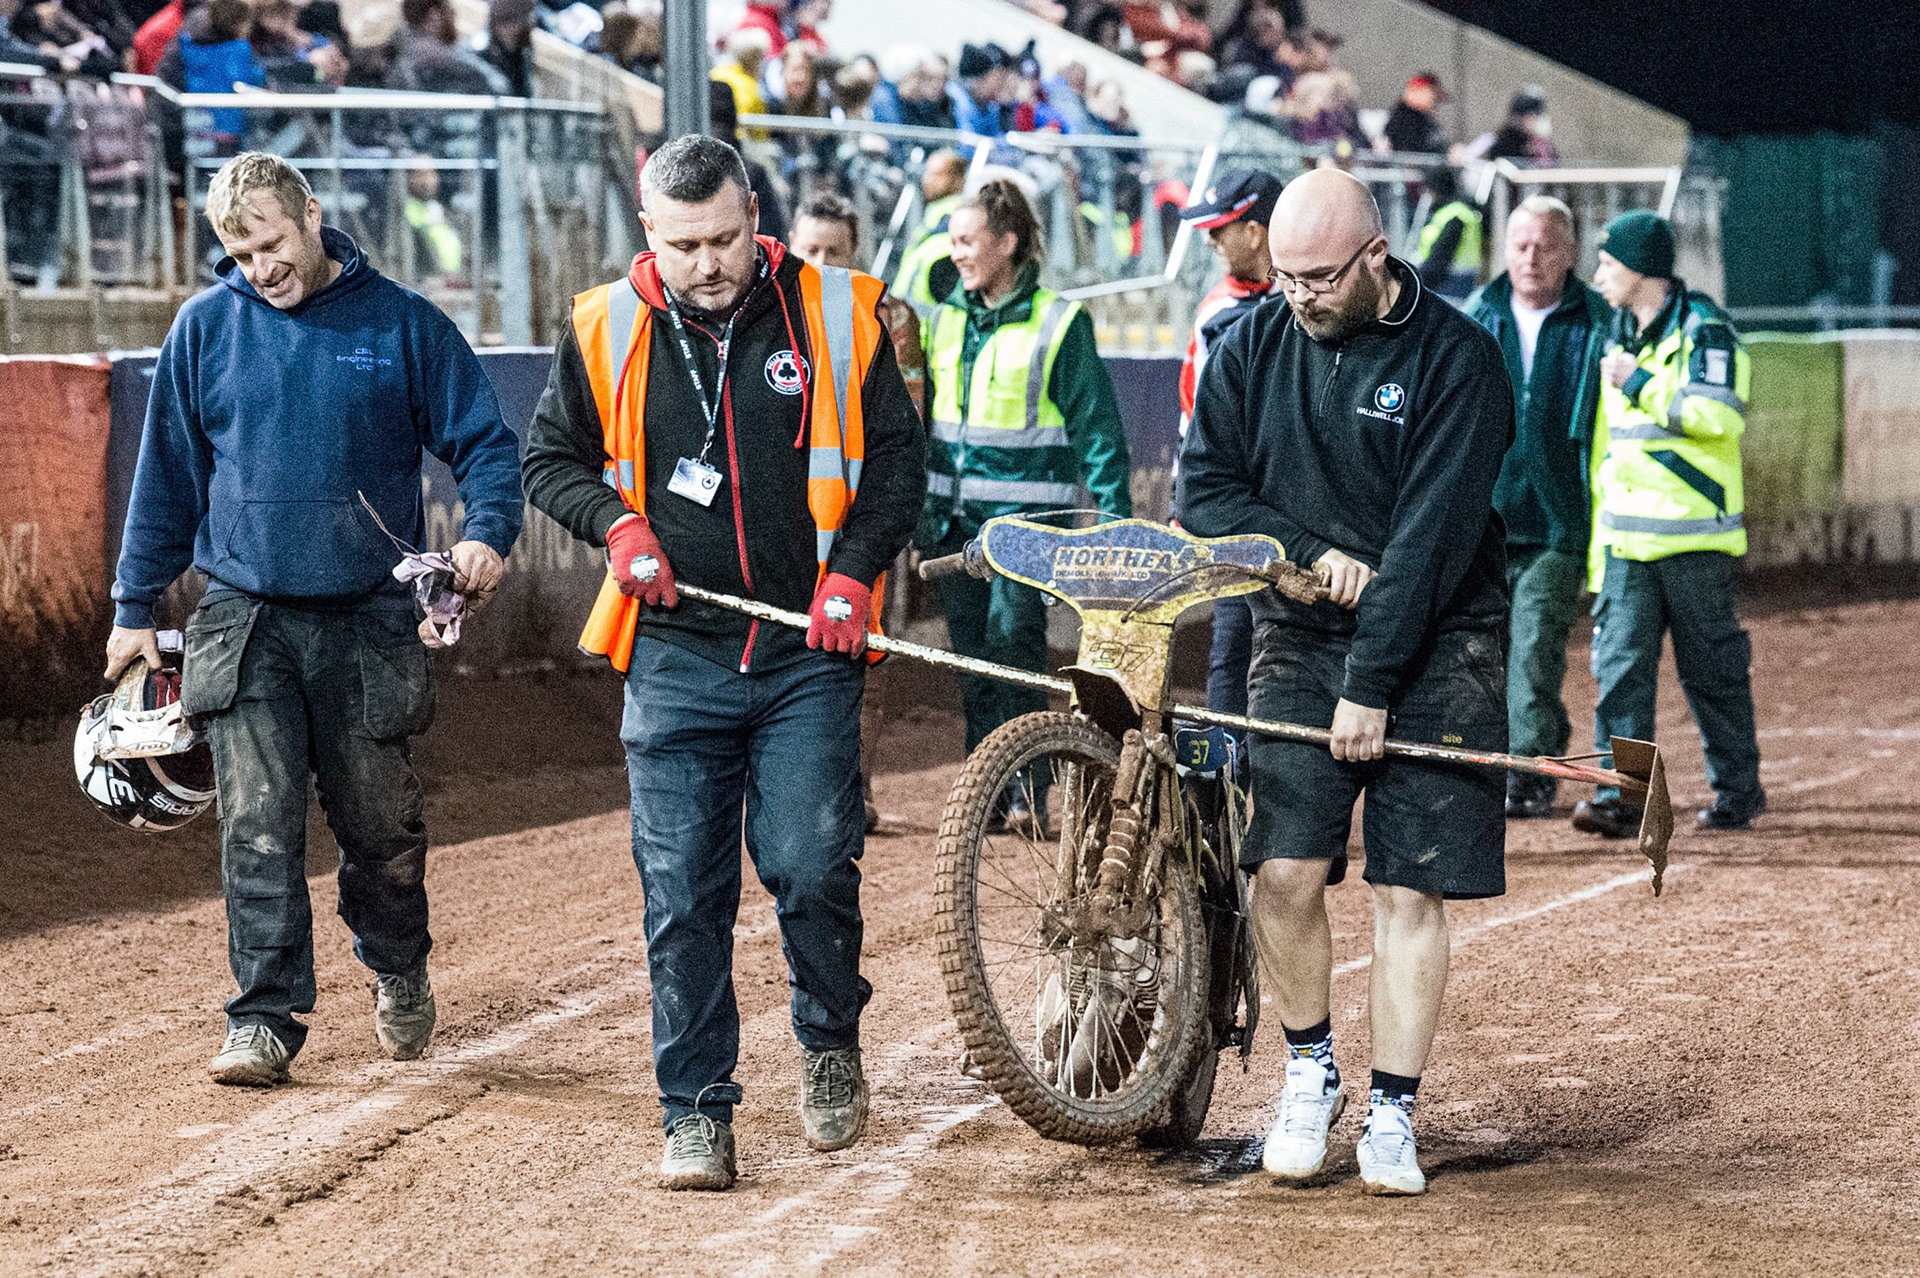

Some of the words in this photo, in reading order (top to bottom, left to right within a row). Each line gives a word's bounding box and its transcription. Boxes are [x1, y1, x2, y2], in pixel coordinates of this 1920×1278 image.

[670, 310, 683, 330] STAFF
[680, 339, 692, 359] STAFF
[690, 369, 702, 390] STAFF
[1090, 640, 1155, 672] 37
[1442, 733, 1463, 744] site
[1191, 739, 1210, 765] 37
